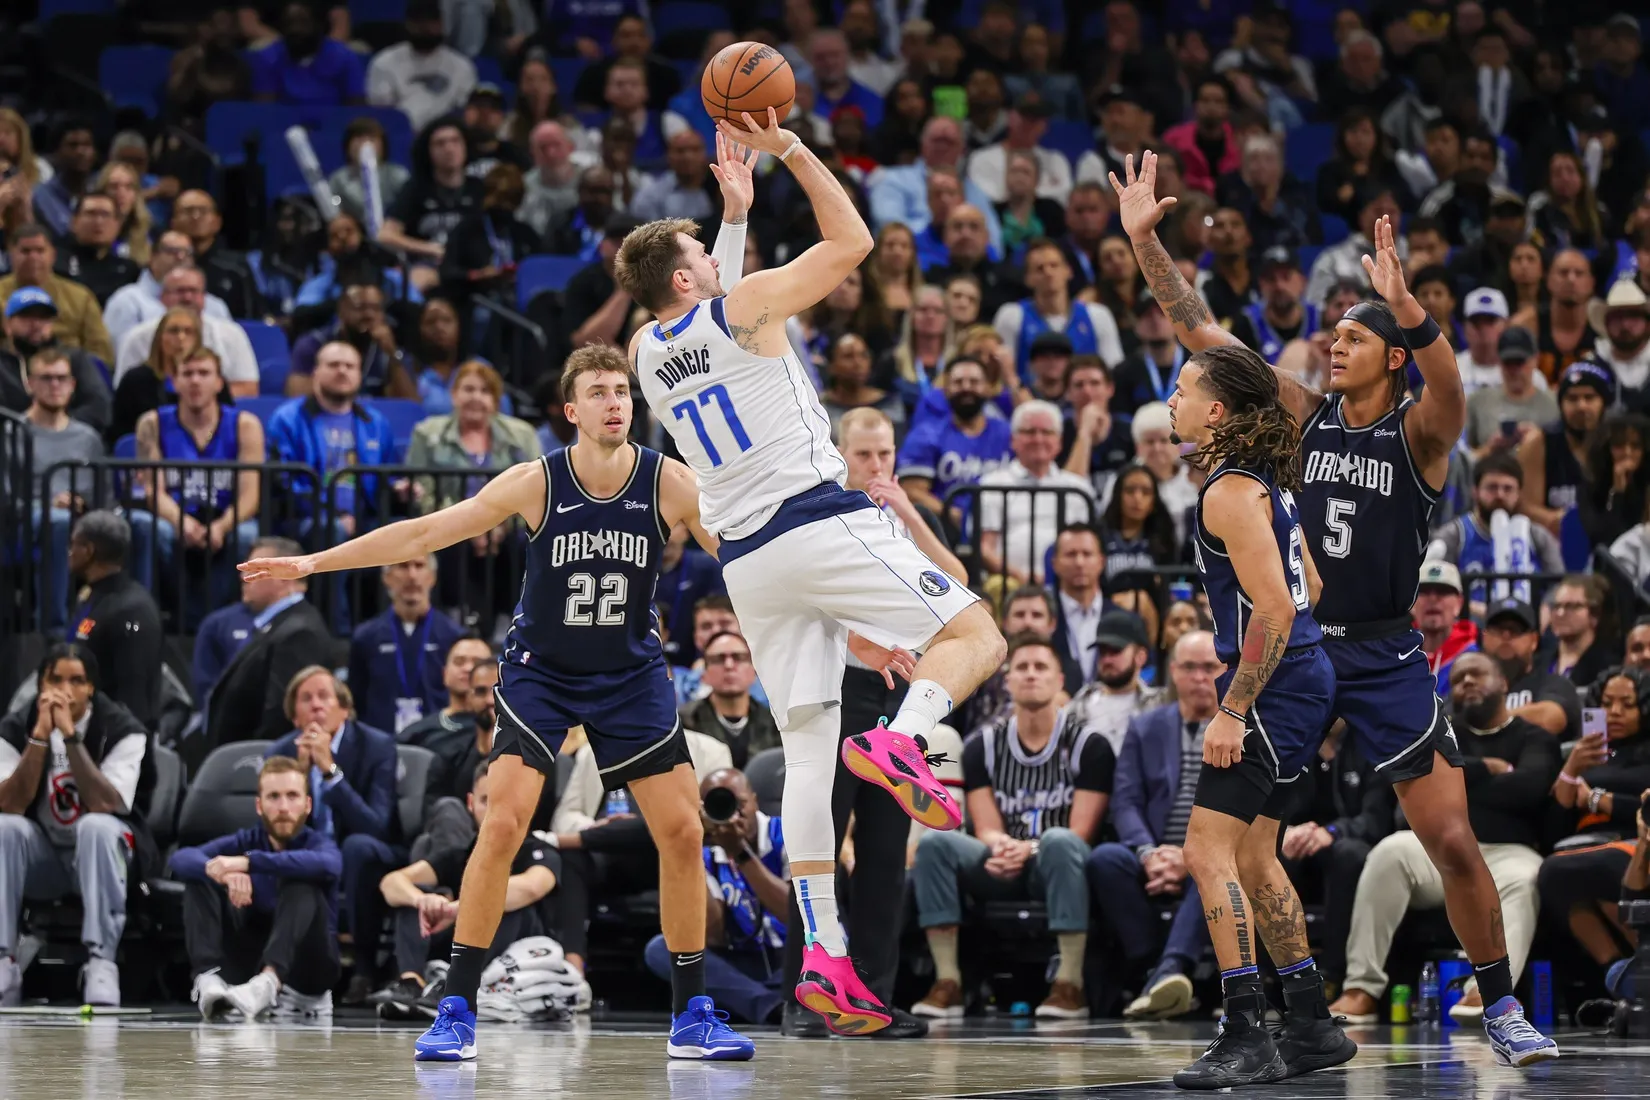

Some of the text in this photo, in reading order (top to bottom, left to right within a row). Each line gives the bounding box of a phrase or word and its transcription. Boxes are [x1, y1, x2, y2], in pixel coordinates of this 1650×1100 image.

[655, 344, 710, 391] DONČIĆ
[671, 384, 753, 468] 77
[1373, 428, 1397, 438] Disney
[622, 499, 649, 512] Disney
[1322, 497, 1356, 559] 5
[563, 572, 629, 626] 22
[1225, 881, 1247, 920] COUNT
